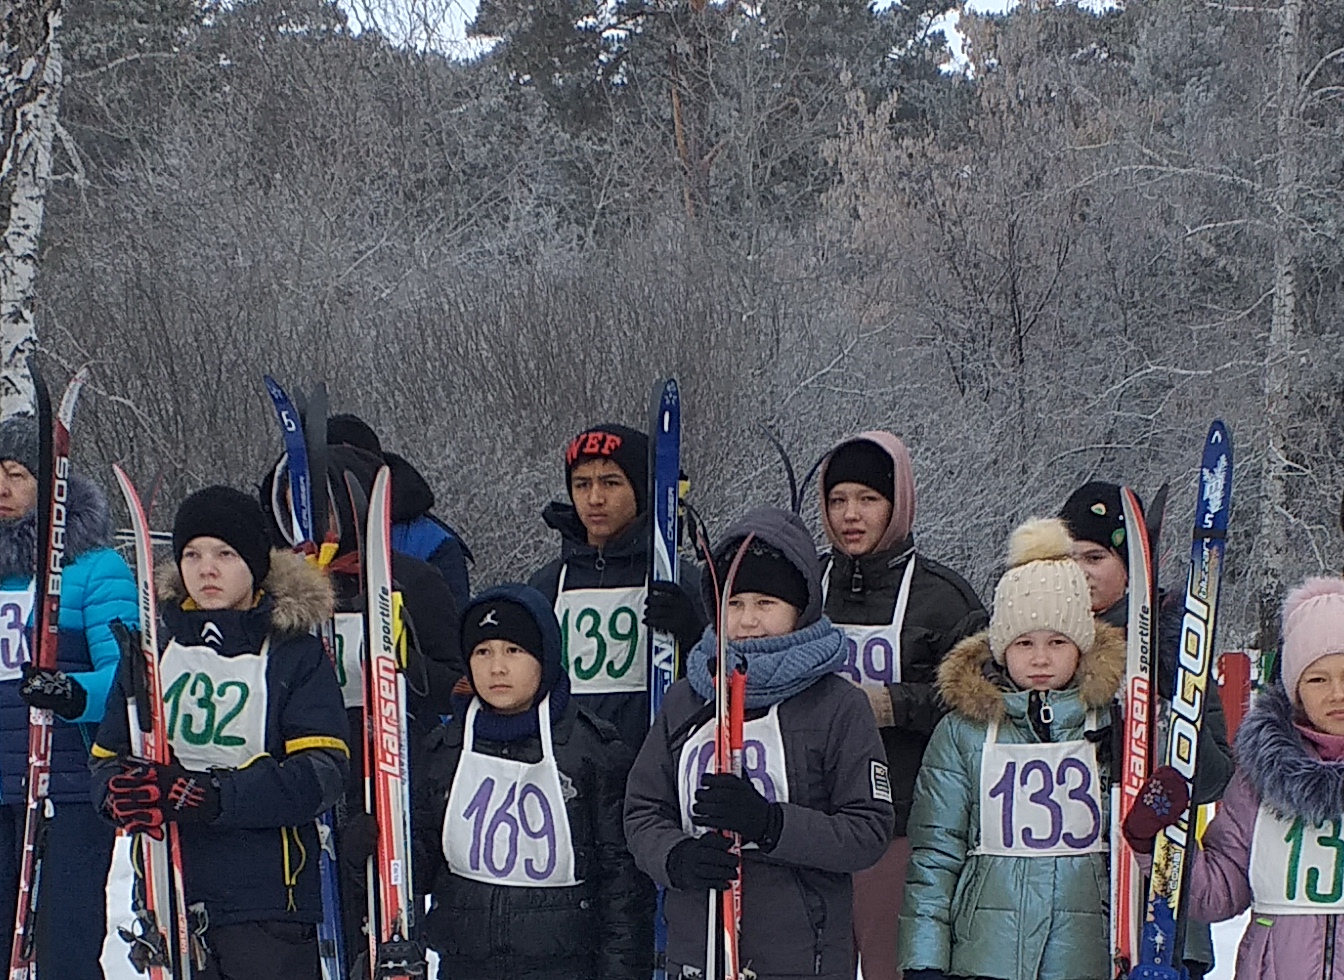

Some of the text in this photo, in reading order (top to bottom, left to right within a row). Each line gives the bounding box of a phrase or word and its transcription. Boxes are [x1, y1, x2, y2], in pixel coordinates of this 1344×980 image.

[47, 456, 70, 596] BRADOS
[143, 580, 151, 647] sportlife
[379, 586, 392, 654] sportlife
[1139, 604, 1151, 674] sportlife
[163, 671, 250, 747] 132
[378, 656, 401, 779] Larsen
[1124, 677, 1149, 797] Larsen
[462, 776, 557, 881] 169
[988, 757, 1102, 850] 133
[1169, 850, 1182, 891] COMBI
